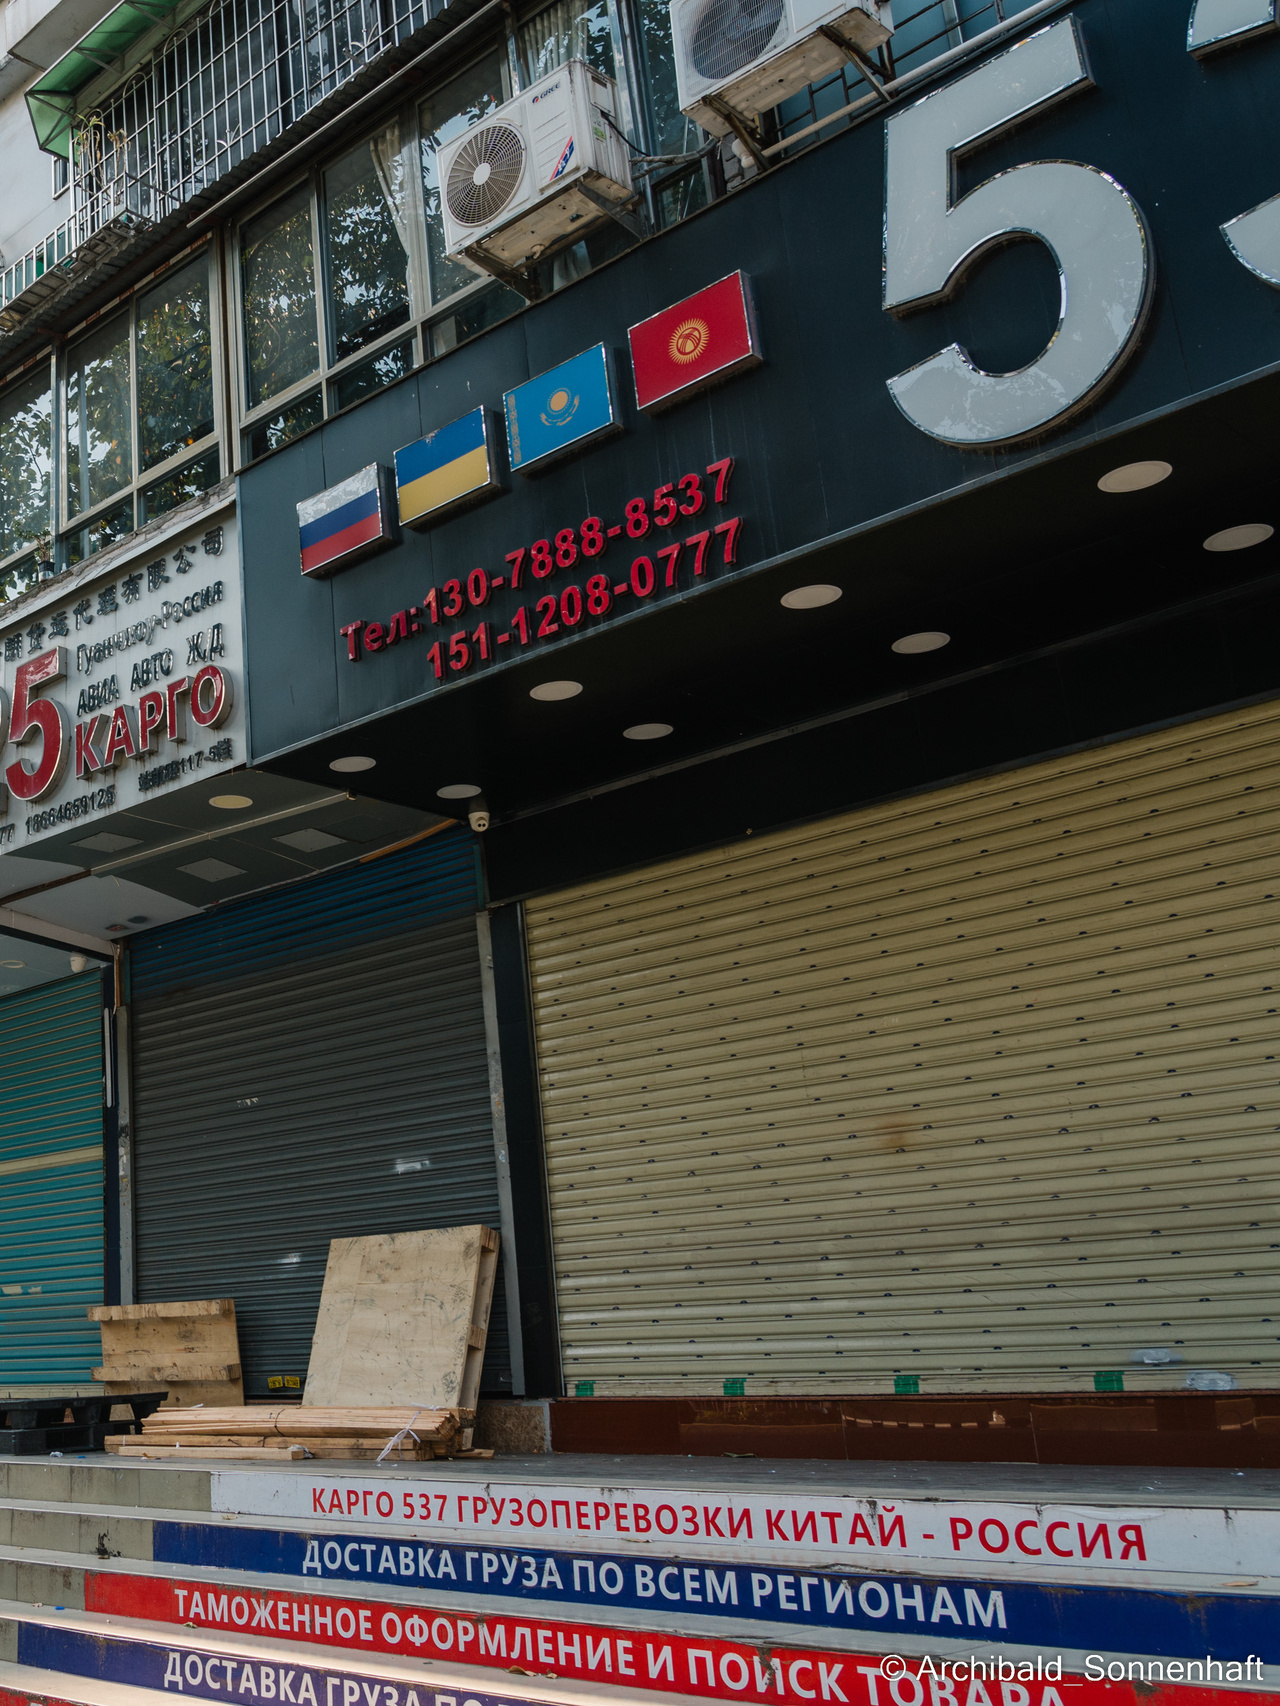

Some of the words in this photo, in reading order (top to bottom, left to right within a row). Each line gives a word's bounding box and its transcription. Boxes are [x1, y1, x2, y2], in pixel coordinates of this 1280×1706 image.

[426, 516, 744, 680] 151-1208-0777
[75, 664, 235, 781] КАРГО
[77, 673, 120, 718] АВИА
[130, 647, 174, 692] АВТО
[312, 1487, 395, 1516] КАРГО
[402, 1492, 447, 1522] 537
[457, 1494, 755, 1540] ГРУЗОПЕРЕВОЗКИ
[766, 1504, 908, 1549] КИТАЙ
[949, 1516, 1149, 1562] РОССИЯ
[302, 1539, 458, 1581] ДОСТАВКА
[465, 1551, 564, 1590] ГРУЗА
[574, 1557, 625, 1595] ПО
[635, 1562, 738, 1606] ВСЕМ
[752, 1571, 1009, 1630] РЕГИОНАМ
[164, 1651, 317, 1705] ДОСТАВКА
[174, 1587, 374, 1643] ТАМОЖЕННОЕ
[381, 1610, 634, 1677] ОФОРМЛЕНИЕ
[646, 1644, 673, 1679] И
[687, 1648, 848, 1703] ПОИСК
